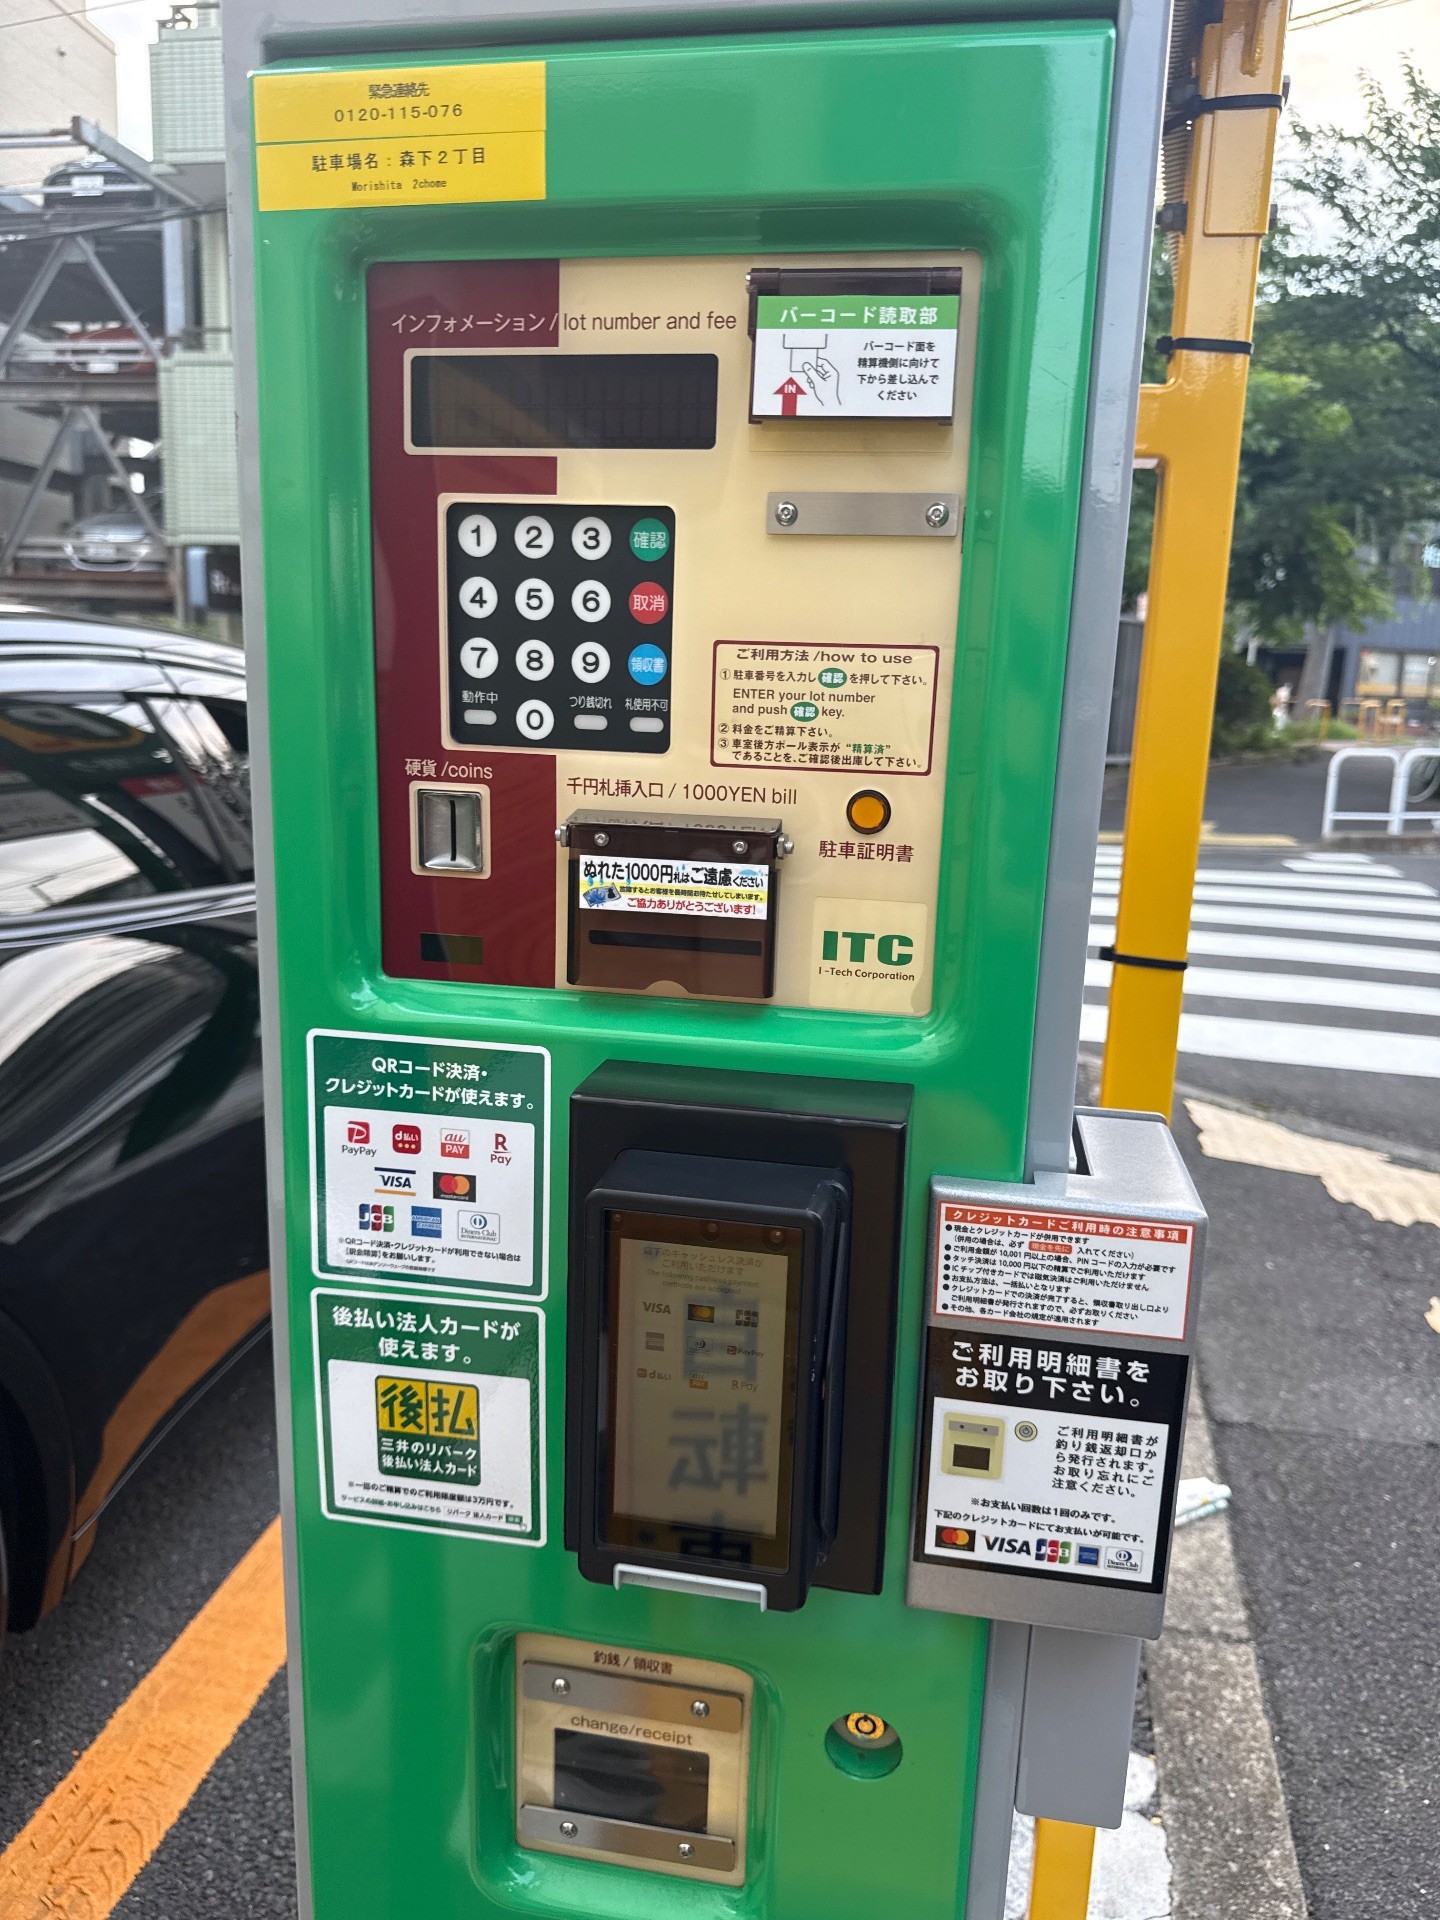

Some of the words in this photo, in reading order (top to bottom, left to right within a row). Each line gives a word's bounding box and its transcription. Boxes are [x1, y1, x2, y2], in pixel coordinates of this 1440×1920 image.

[369, 82, 431, 99] 緊急連絡先
[334, 104, 463, 122] 0120-115-076
[351, 180, 402, 192] Morishita
[412, 178, 447, 190] 2chome
[563, 313, 586, 331] lot
[592, 312, 660, 331] number
[666, 311, 701, 330] and
[707, 311, 737, 329] fee
[780, 306, 938, 325] バーコード読取部
[863, 342, 936, 352] バーコード面を
[857, 357, 940, 369] 精算機側に向けて
[784, 384, 797, 394] IN
[857, 374, 940, 385] 下から差し込んで
[877, 391, 917, 401] ください
[471, 525, 481, 547] 1
[526, 526, 543, 549] 2
[583, 527, 600, 550] 3
[633, 532, 666, 549] 確認
[470, 587, 487, 609] 4
[526, 588, 543, 611] 5
[583, 590, 600, 612] 6
[633, 595, 665, 612] 取消
[470, 646, 488, 669] 7
[526, 650, 544, 671] 8
[582, 652, 600, 674] 9
[630, 657, 665, 673] 領収書
[736, 648, 809, 662] ご利用方法
[861, 652, 877, 663] to
[883, 654, 912, 664] use
[462, 690, 498, 703] 動作中
[569, 696, 612, 709] つり銭切れ
[625, 698, 668, 712] 札使用不可
[733, 689, 775, 700] ENTER
[779, 692, 806, 703] your
[810, 690, 824, 701] lot
[829, 692, 875, 703] number
[526, 709, 544, 730] 0
[732, 703, 754, 714] and
[758, 704, 787, 716] push
[793, 706, 816, 718] 確認
[821, 706, 845, 717] key.
[405, 759, 436, 777] 硬貨
[566, 778, 664, 799] 千円札挿入口
[683, 784, 767, 804] 1000YEN
[771, 787, 797, 805] bill
[819, 840, 914, 863] 駐車証明書
[822, 930, 914, 966] ITC
[855, 969, 914, 981] Corporation
[325, 1078, 533, 1110] クレジットカードが使えます。
[395, 1131, 418, 1141] d払い
[443, 1132, 466, 1142] au
[495, 1133, 508, 1150] R
[341, 1145, 377, 1157] PayPay
[445, 1144, 465, 1154] PAY
[490, 1154, 512, 1166] Pay
[380, 1174, 412, 1188] VISA
[412, 1215, 440, 1223] AMERICAN
[417, 1222, 442, 1230] EXPRESS
[952, 1210, 1180, 1241] クレジットカードご利用時の注意事項
[461, 1227, 482, 1236] Diners
[483, 1229, 497, 1237] Club
[953, 1224, 1090, 1244] 現金とクレジットカードが併用できます
[642, 1302, 672, 1315] VISA
[332, 1305, 521, 1341] 後払い法人カードが
[378, 1336, 472, 1365] 使えます。
[738, 1347, 764, 1358] PayPay
[951, 1341, 1150, 1384] ご利用明細書を
[741, 1381, 758, 1392] Pay
[955, 1366, 1140, 1408] お取り下さい。
[380, 1382, 475, 1436] 後払
[1057, 1425, 1159, 1447] ご利用明細書が
[380, 1437, 477, 1460] 三井のリパーク
[1055, 1439, 1157, 1460] 釣り銭返却口か
[381, 1453, 477, 1478] 後払い法人カード
[1055, 1451, 1154, 1473] ら発行されます。
[1054, 1465, 1153, 1486] お取り忘れにご
[1051, 1478, 1136, 1498] 注意ください。
[934, 1509, 1144, 1543] 下記のクレジットカードにてお支払いが可能です。
[981, 1534, 1032, 1555] VISA
[593, 1650, 620, 1667] 釣銭
[632, 1656, 673, 1675] 領収書
[571, 1714, 693, 1746] change/receipt
